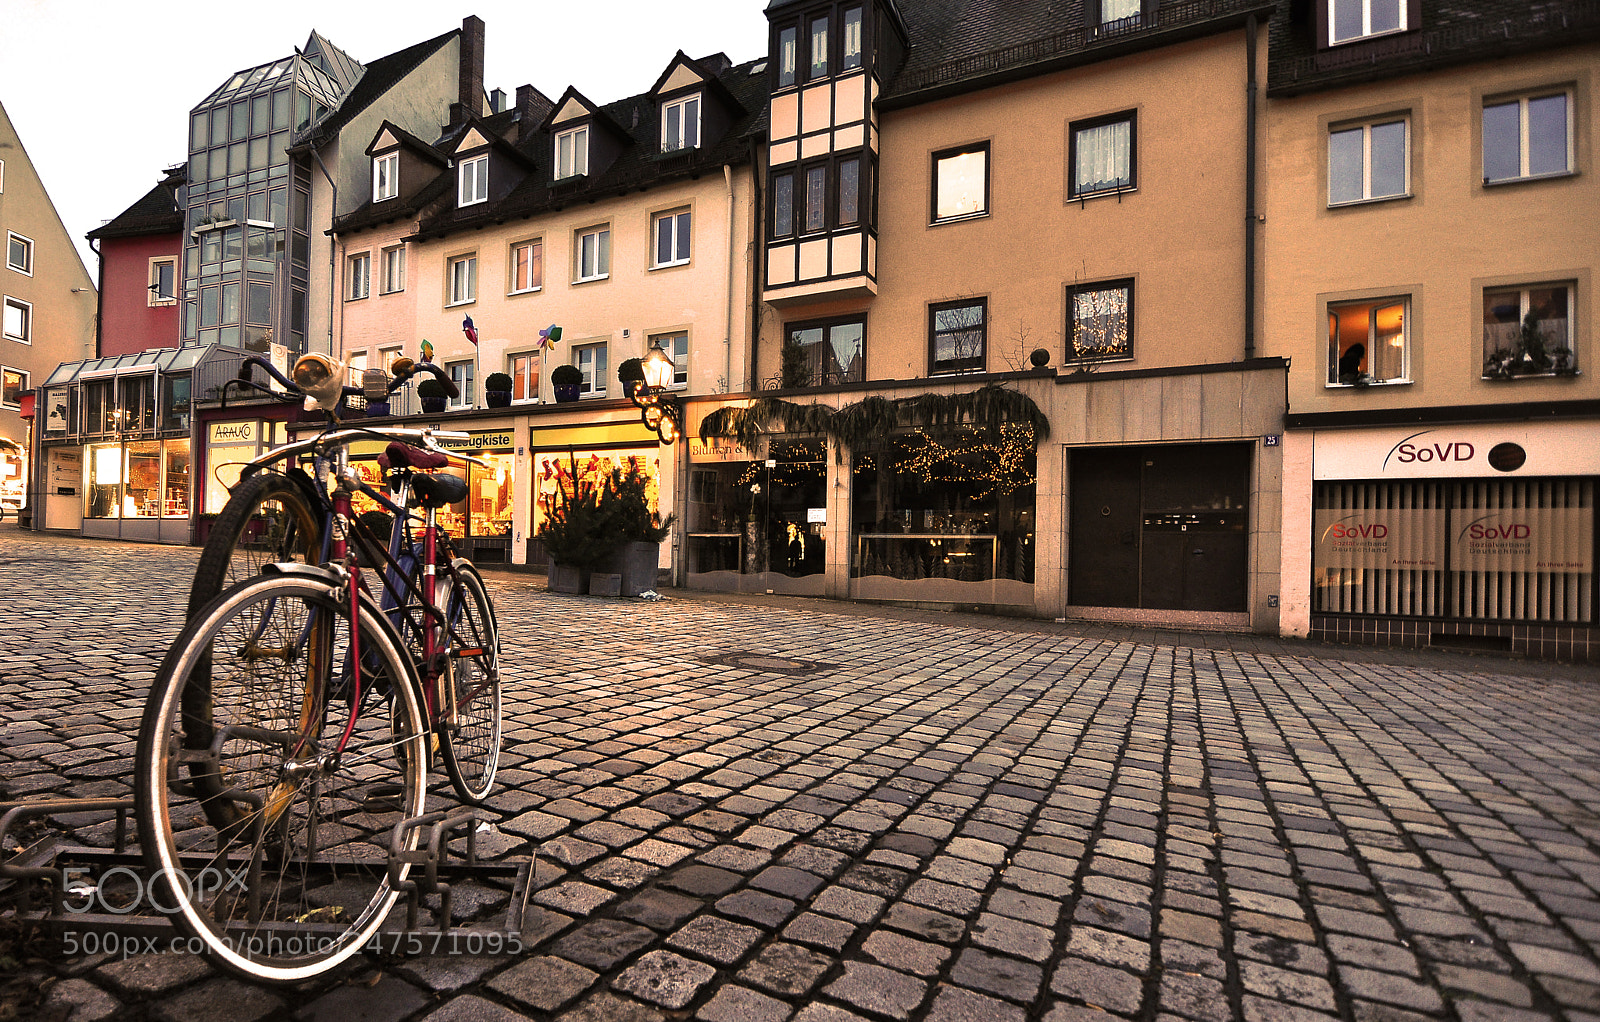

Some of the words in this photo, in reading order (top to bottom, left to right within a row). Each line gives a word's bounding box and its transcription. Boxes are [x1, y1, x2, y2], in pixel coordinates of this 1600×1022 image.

[438, 434, 510, 449] ugkiste
[1267, 436, 1276, 445] 25
[735, 445, 743, 454] &
[1397, 442, 1475, 463] SoVD
[1332, 523, 1388, 539] SoVD
[1469, 524, 1531, 540] SoVD
